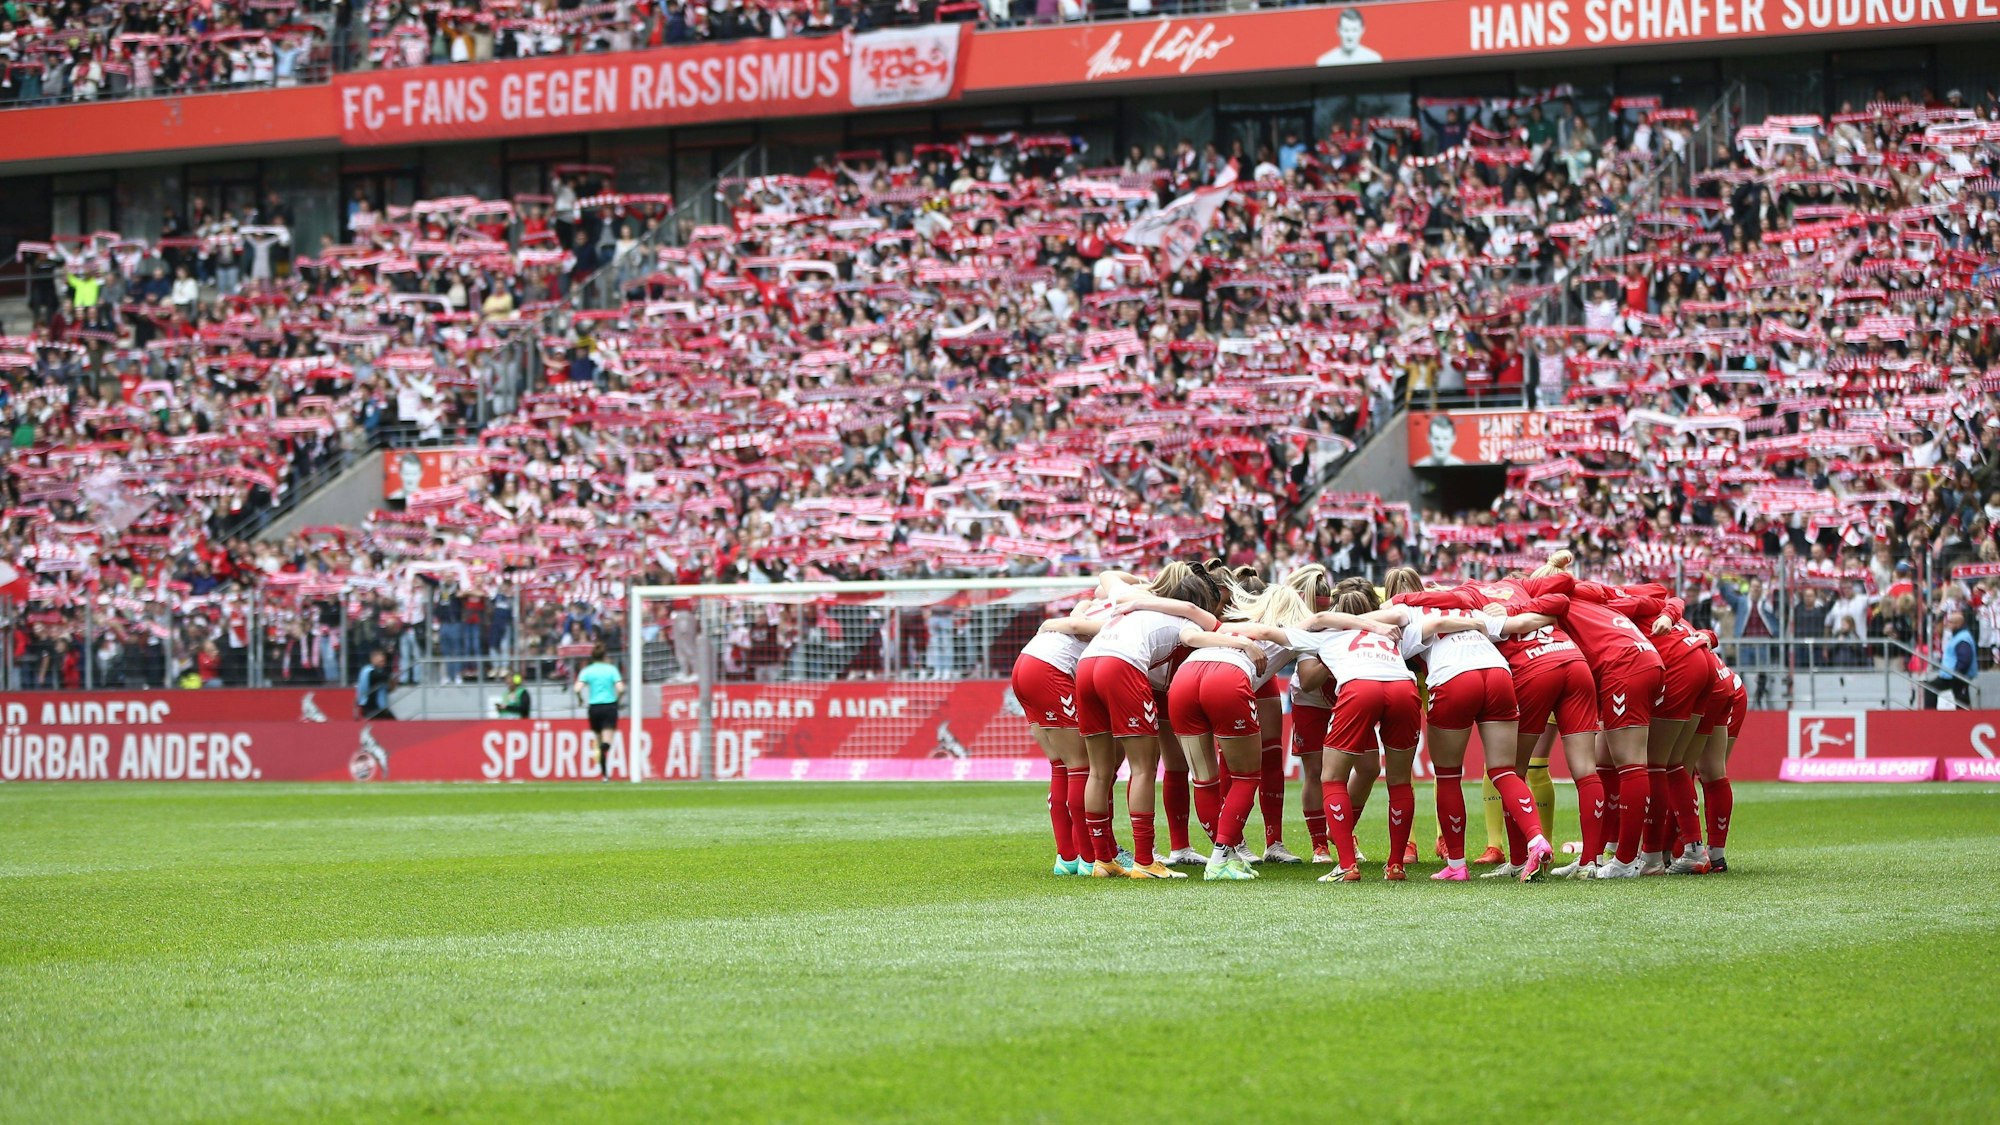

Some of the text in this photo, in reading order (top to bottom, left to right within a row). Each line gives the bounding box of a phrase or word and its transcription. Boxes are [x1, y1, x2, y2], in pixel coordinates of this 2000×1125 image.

[1470, 2, 1571, 50] HANS
[341, 49, 840, 130] FC-FANS GEGEN RASSISMUS
[1525, 639, 1576, 660] hummel
[119, 732, 261, 779] ANDERS.
[1801, 762, 1876, 777] MAGENTA
[1877, 761, 1929, 777] SPORT
